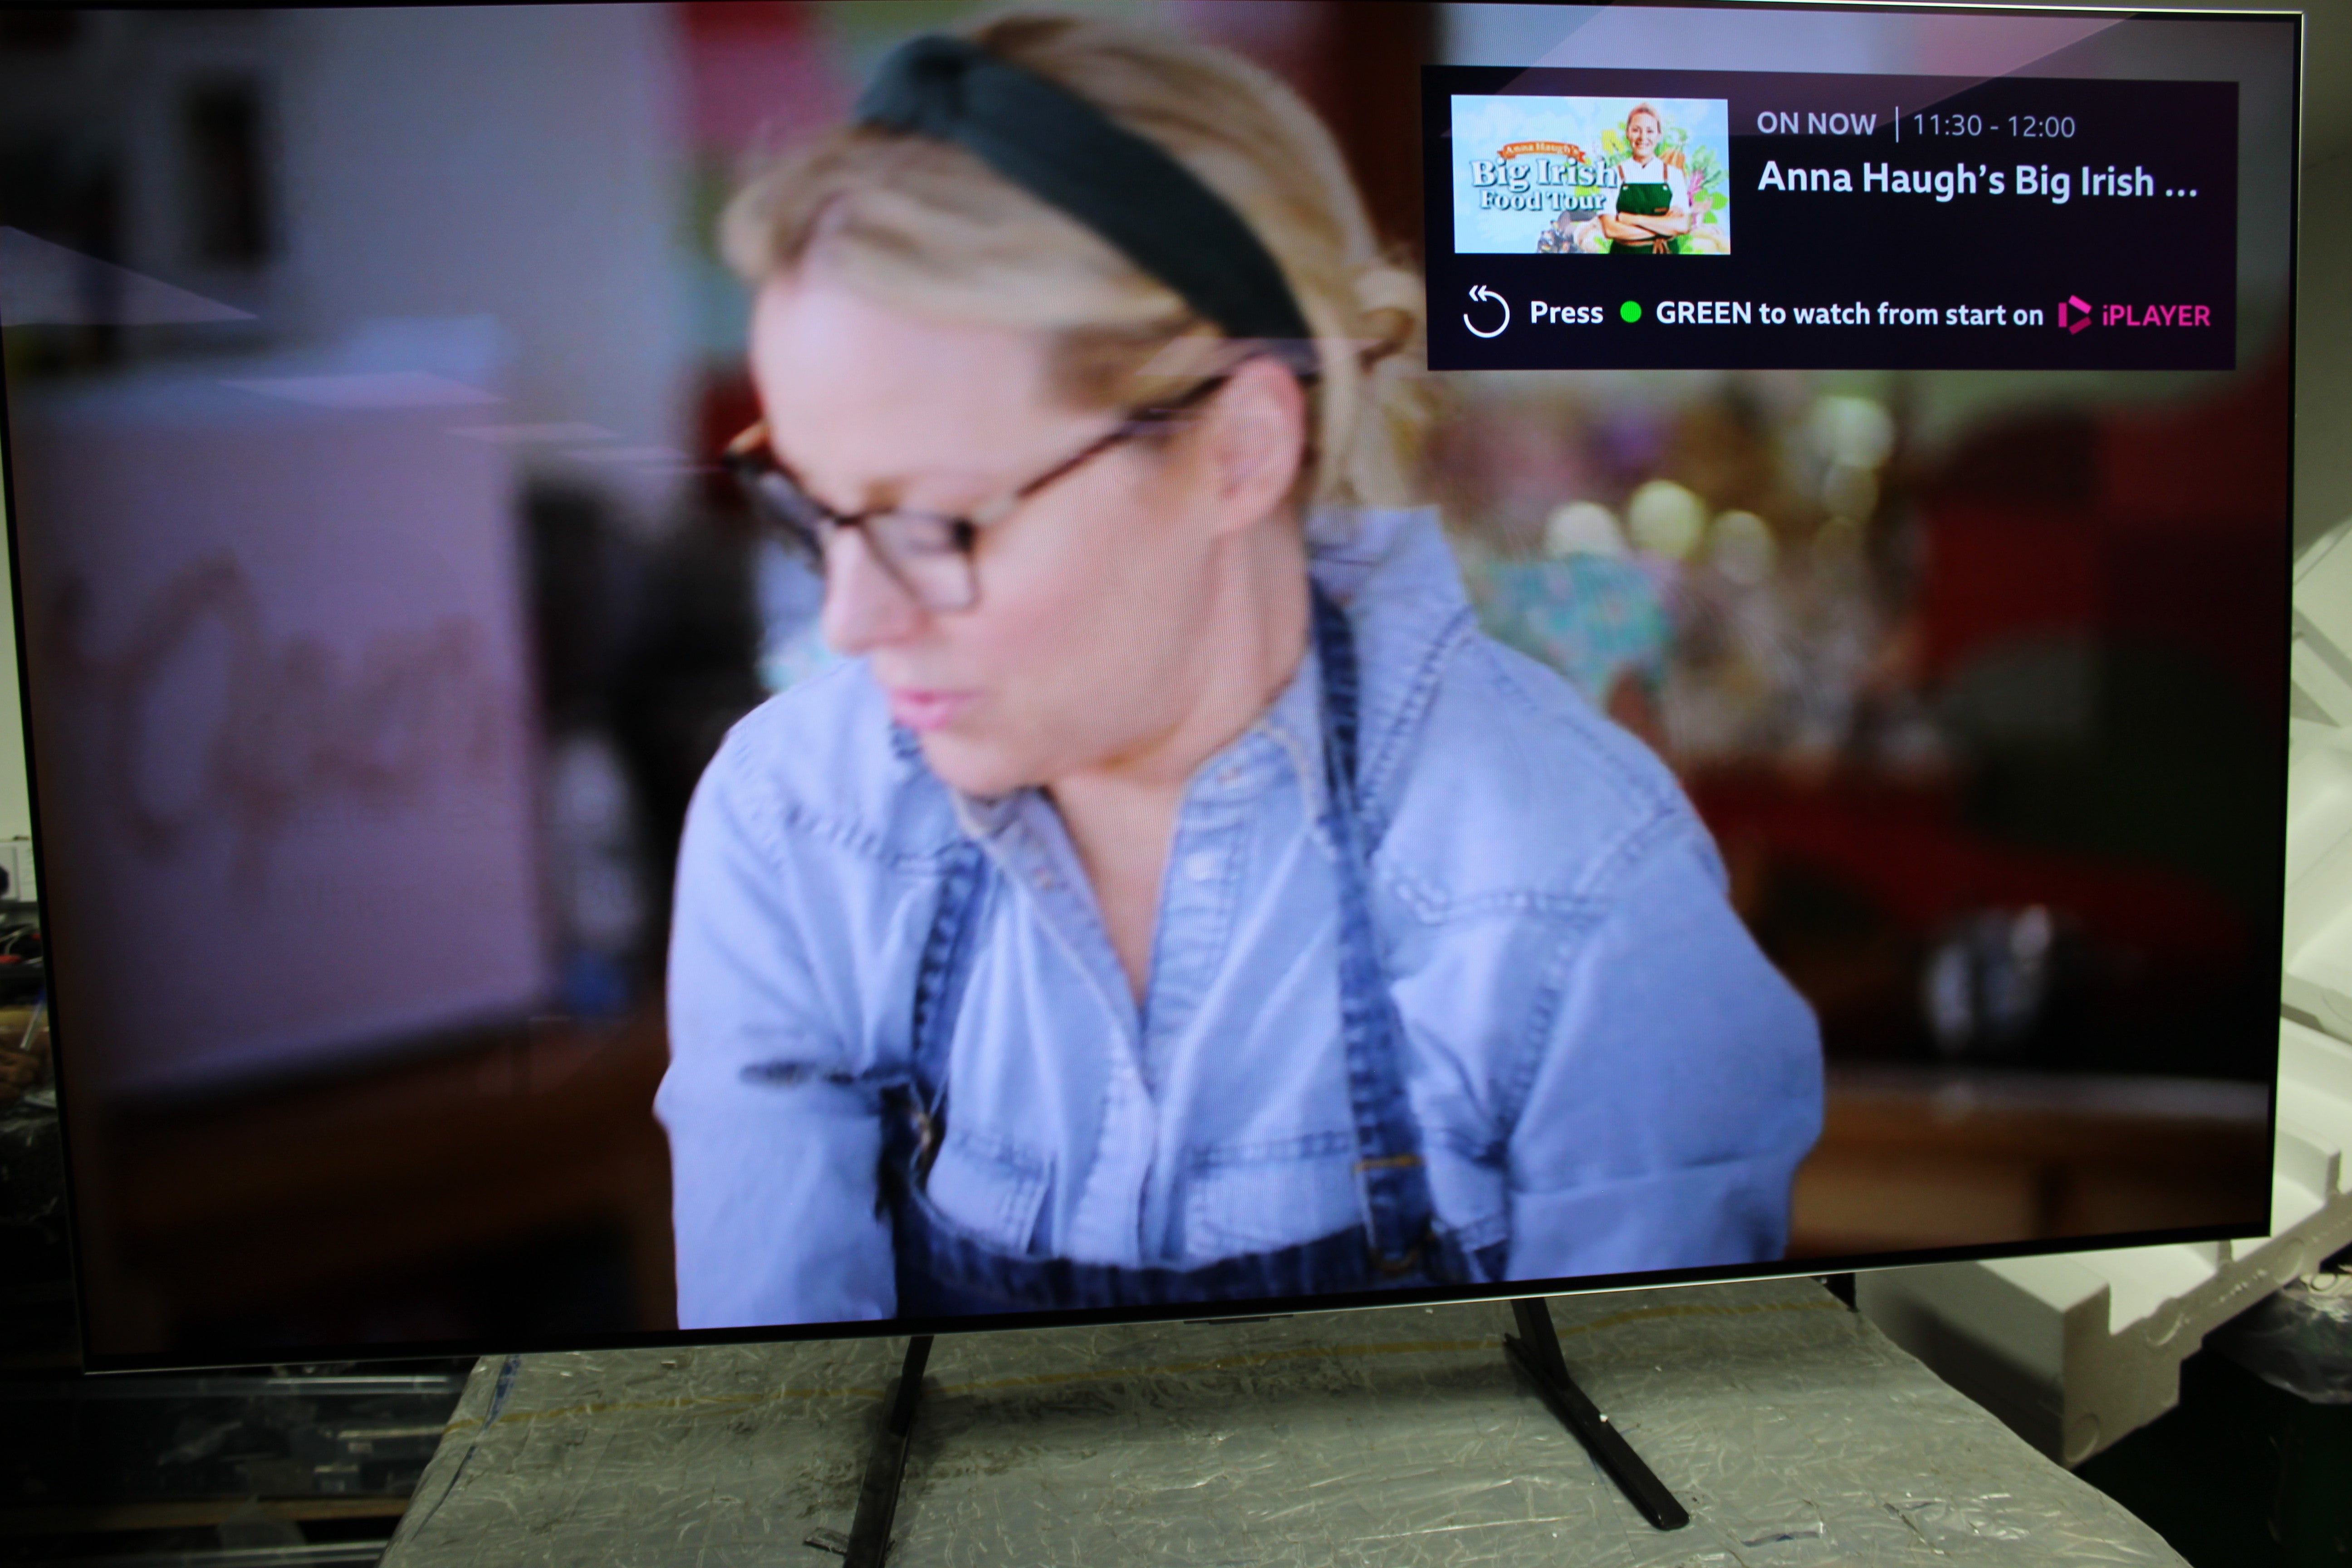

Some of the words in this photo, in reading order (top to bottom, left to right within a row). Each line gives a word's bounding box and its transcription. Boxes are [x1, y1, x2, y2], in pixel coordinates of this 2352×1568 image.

[1757, 111, 1798, 134] ON
[1808, 113, 1877, 135] NOW
[1914, 114, 1982, 136] 11:30
[2009, 116, 2075, 137] 12:00
[1470, 157, 1530, 192] Big
[1536, 157, 1618, 188] Irish
[1758, 160, 1852, 192] Anna
[1864, 162, 2004, 202] Haugh's
[2017, 165, 2070, 204] Big
[2082, 166, 2154, 196] Irish
[1480, 189, 1543, 211] Food
[1546, 191, 1607, 211] Tour
[1530, 300, 1603, 324] Press
[1656, 301, 1751, 324] GREEN
[1759, 304, 1786, 324] to
[1793, 302, 1870, 324] watch
[1877, 302, 1938, 325] from
[1946, 305, 2007, 325] start
[2013, 309, 2043, 325] on
[2103, 304, 2210, 326] iPLAYER
